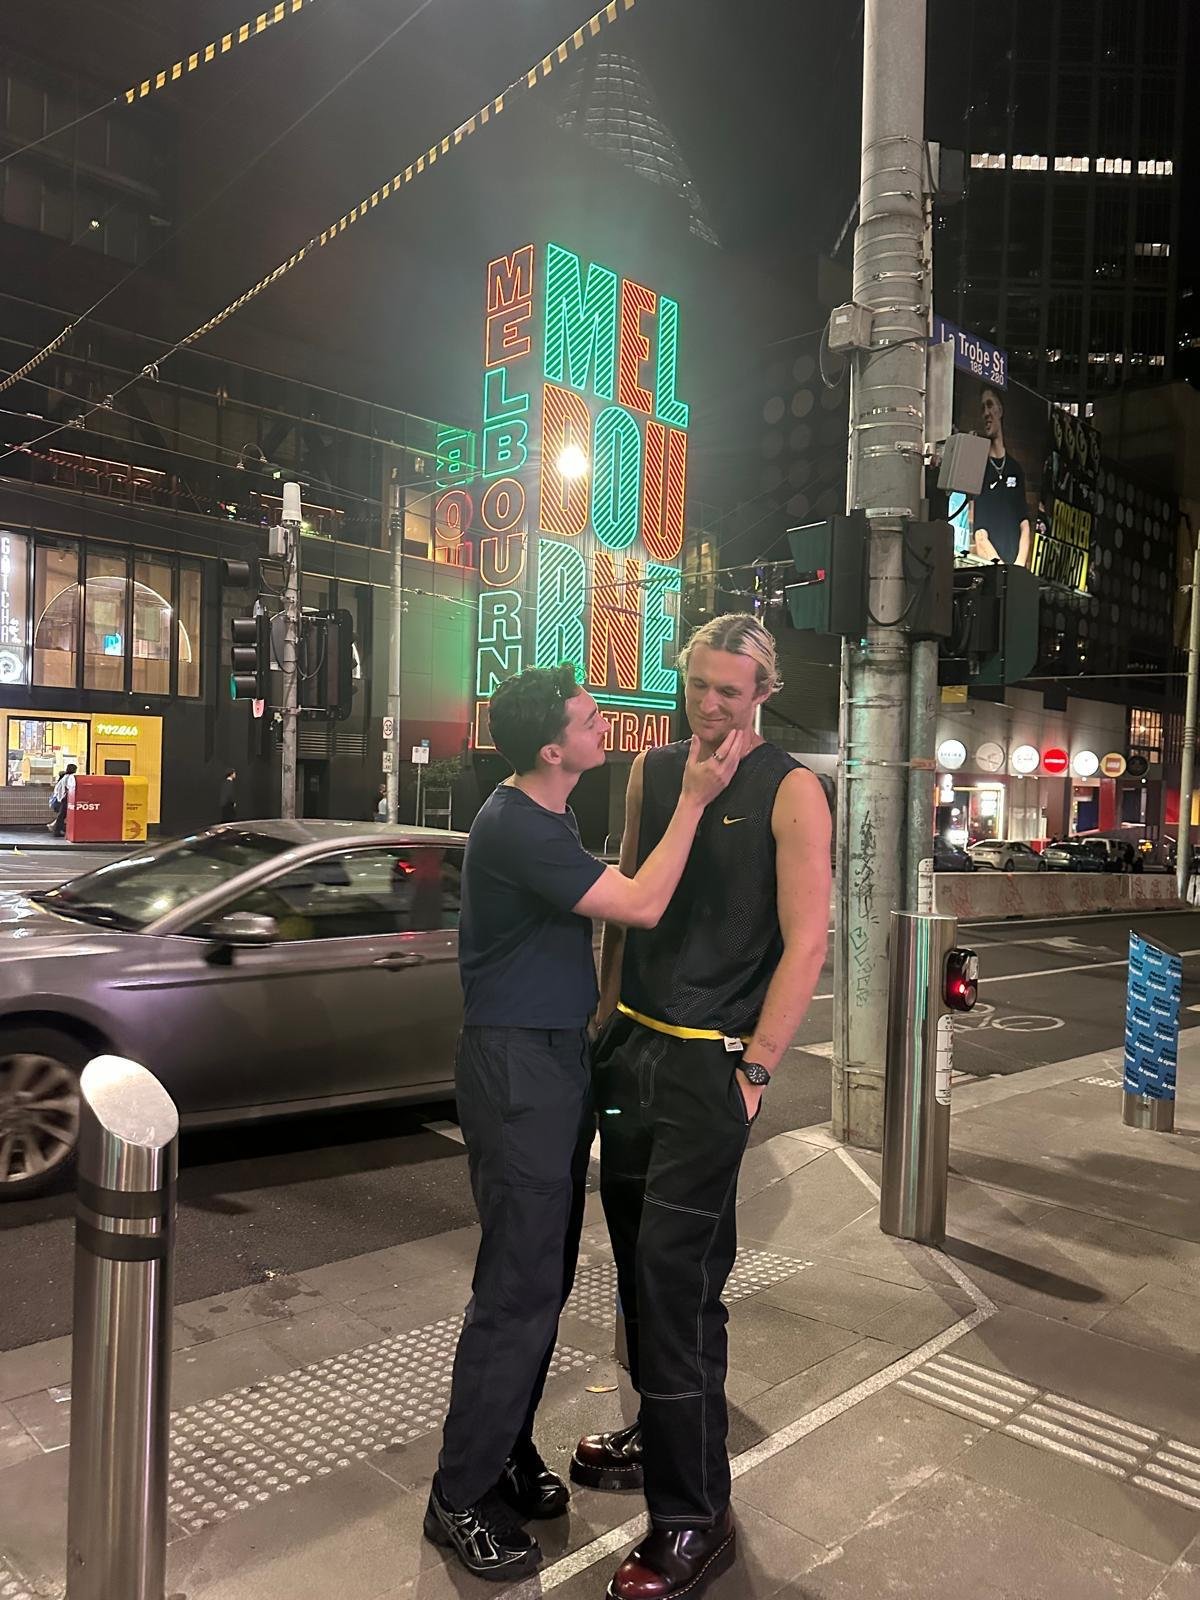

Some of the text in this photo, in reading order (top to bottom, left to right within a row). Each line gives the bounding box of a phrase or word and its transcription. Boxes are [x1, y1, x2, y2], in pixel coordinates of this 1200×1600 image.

[543, 243, 689, 428] MEL
[958, 332, 990, 367] Trobe
[993, 351, 1004, 375] St
[536, 539, 681, 694] RNE
[76, 803, 100, 811] POST
